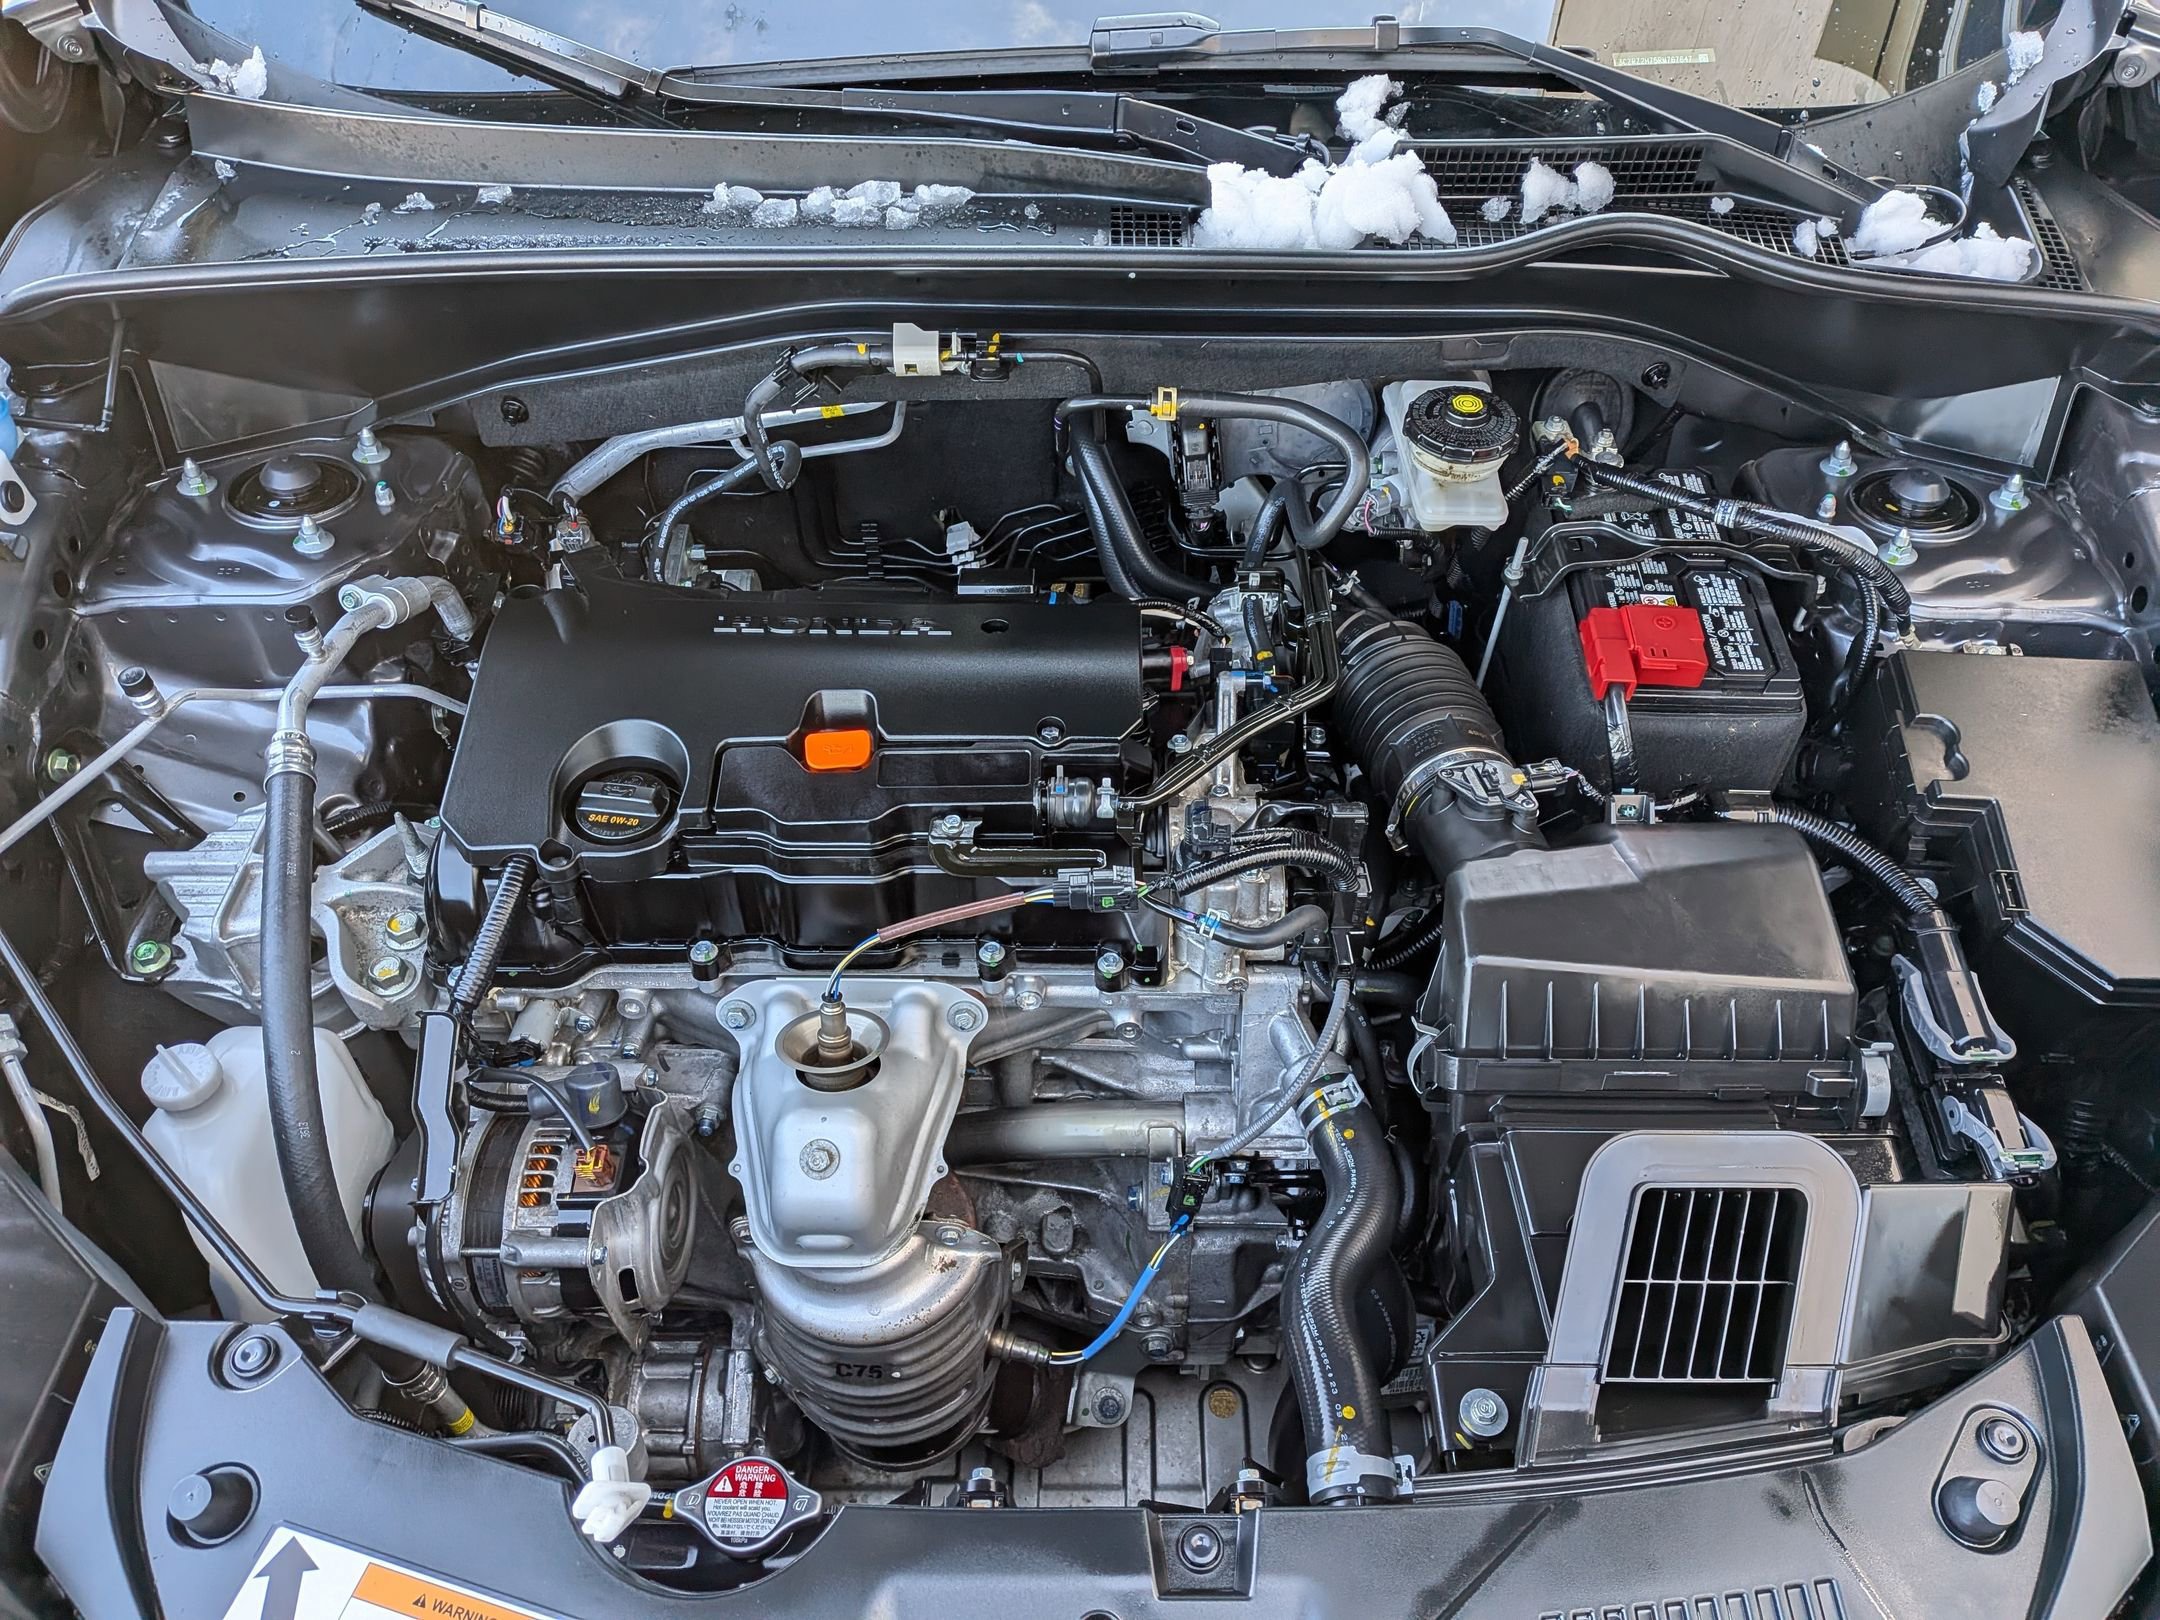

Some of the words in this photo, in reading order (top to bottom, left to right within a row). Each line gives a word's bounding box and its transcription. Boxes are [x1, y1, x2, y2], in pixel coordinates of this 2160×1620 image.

[588, 813, 609, 823] SAE
[610, 816, 639, 827] 0W-20
[836, 1363, 882, 1379] C75
[1330, 1380, 1339, 1395] 23
[735, 1465, 770, 1474] DANGER
[734, 1473, 776, 1482] WARNUNG
